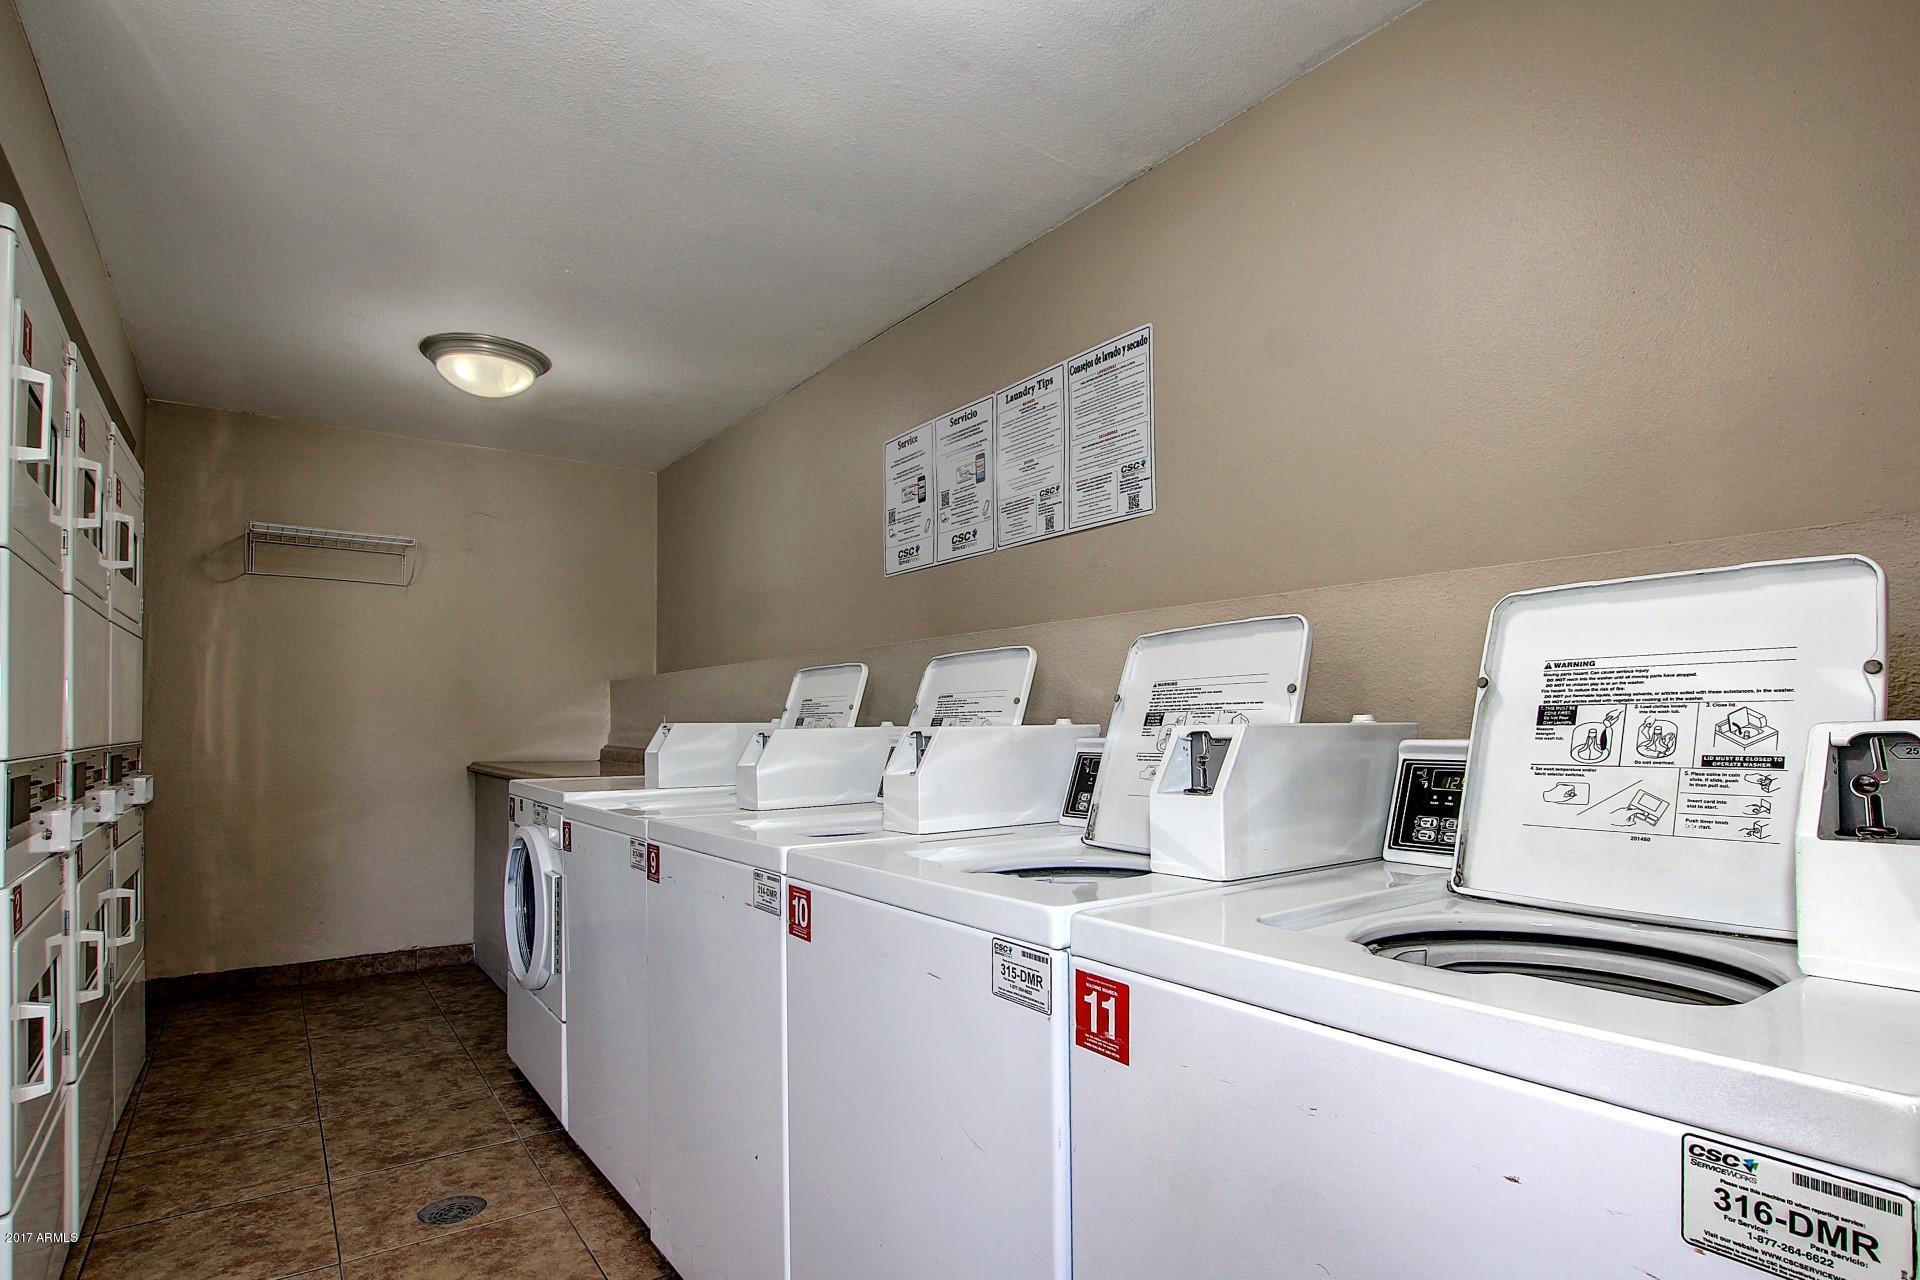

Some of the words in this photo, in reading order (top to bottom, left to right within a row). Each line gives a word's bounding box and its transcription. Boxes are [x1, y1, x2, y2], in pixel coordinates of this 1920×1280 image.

[1069, 359, 1093, 376] Consejos
[1094, 353, 1101, 366] de
[1102, 346, 1121, 363] lavado
[1121, 345, 1126, 357] y
[1126, 335, 1148, 352] secado
[1005, 385, 1036, 405] Laundry
[1037, 377, 1054, 390] Tips
[949, 408, 978, 428] Servicio
[898, 435, 918, 450] Service
[1121, 462, 1140, 473] CSC
[1039, 486, 1055, 497] CSC
[951, 531, 971, 545] CSC
[898, 546, 915, 559] CSC
[1554, 660, 1596, 669] WARNING
[650, 852, 657, 874] 9
[15, 893, 20, 919] 2
[792, 896, 809, 928] 10
[994, 943, 1008, 953] CSC
[1000, 963, 1043, 989] 315-DMR
[1084, 990, 1116, 1040] 11
[1688, 1144, 1741, 1167] CSC
[1690, 1158, 1758, 1184] SERVICEWORKS
[1720, 1178, 1738, 1188] Please
[1750, 1187, 1761, 1195] this
[1761, 1191, 1785, 1203] machine
[1793, 1203, 1811, 1212] when
[1811, 1206, 1840, 1221] reporting
[1840, 1216, 1866, 1229] service:
[1713, 1187, 1882, 1264] 316-DMR
[1724, 1214, 1737, 1225] For
[1738, 1218, 1769, 1235] Service:
[1704, 1229, 1719, 1240] Visit
[1720, 1235, 1731, 1244] our
[1732, 1239, 1759, 1254] website
[1746, 1231, 1835, 1269] 1-877-264-6622
[1810, 1243, 1829, 1257] Para
[1830, 1249, 1869, 1270] Servicio:
